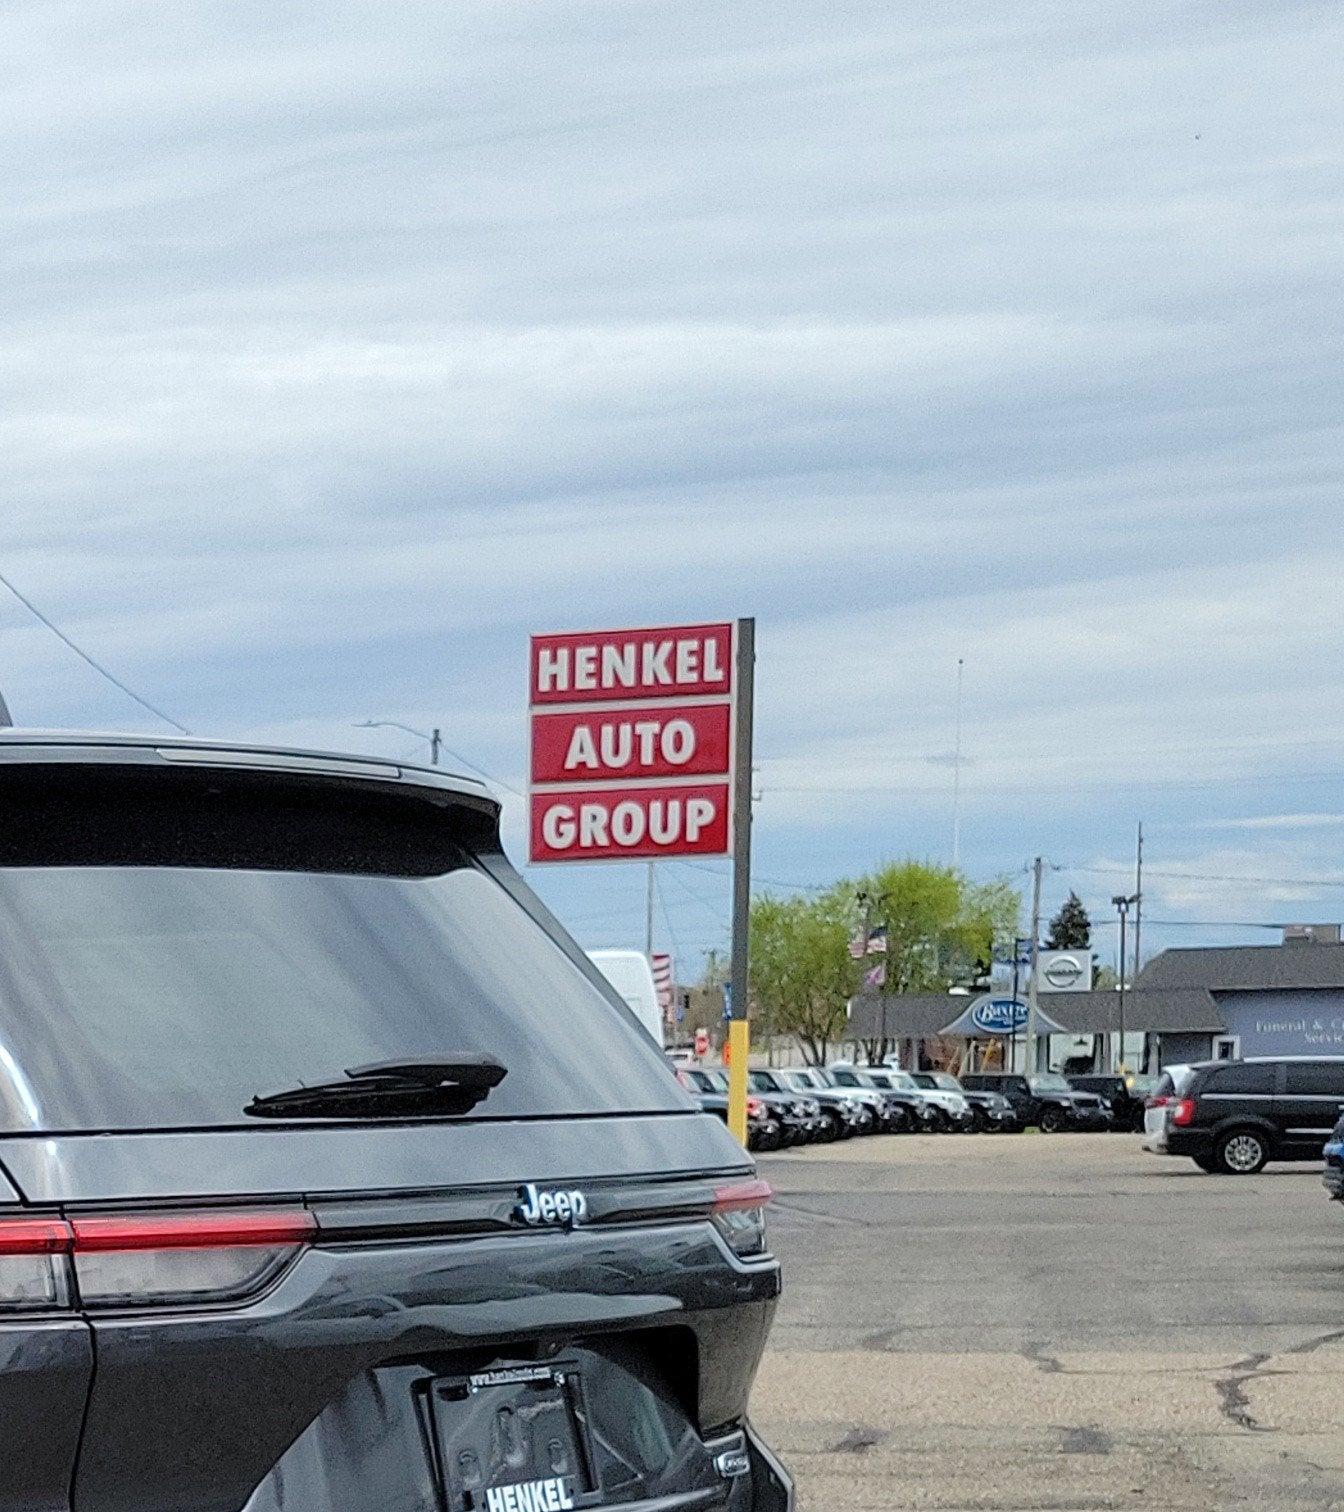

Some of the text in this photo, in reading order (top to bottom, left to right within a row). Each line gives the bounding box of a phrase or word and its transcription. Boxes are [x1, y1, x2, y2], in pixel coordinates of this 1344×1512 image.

[537, 638, 724, 692] HENKEL
[564, 718, 696, 770] AUTO
[542, 798, 716, 850] GROUP
[520, 1183, 587, 1228] Jeep
